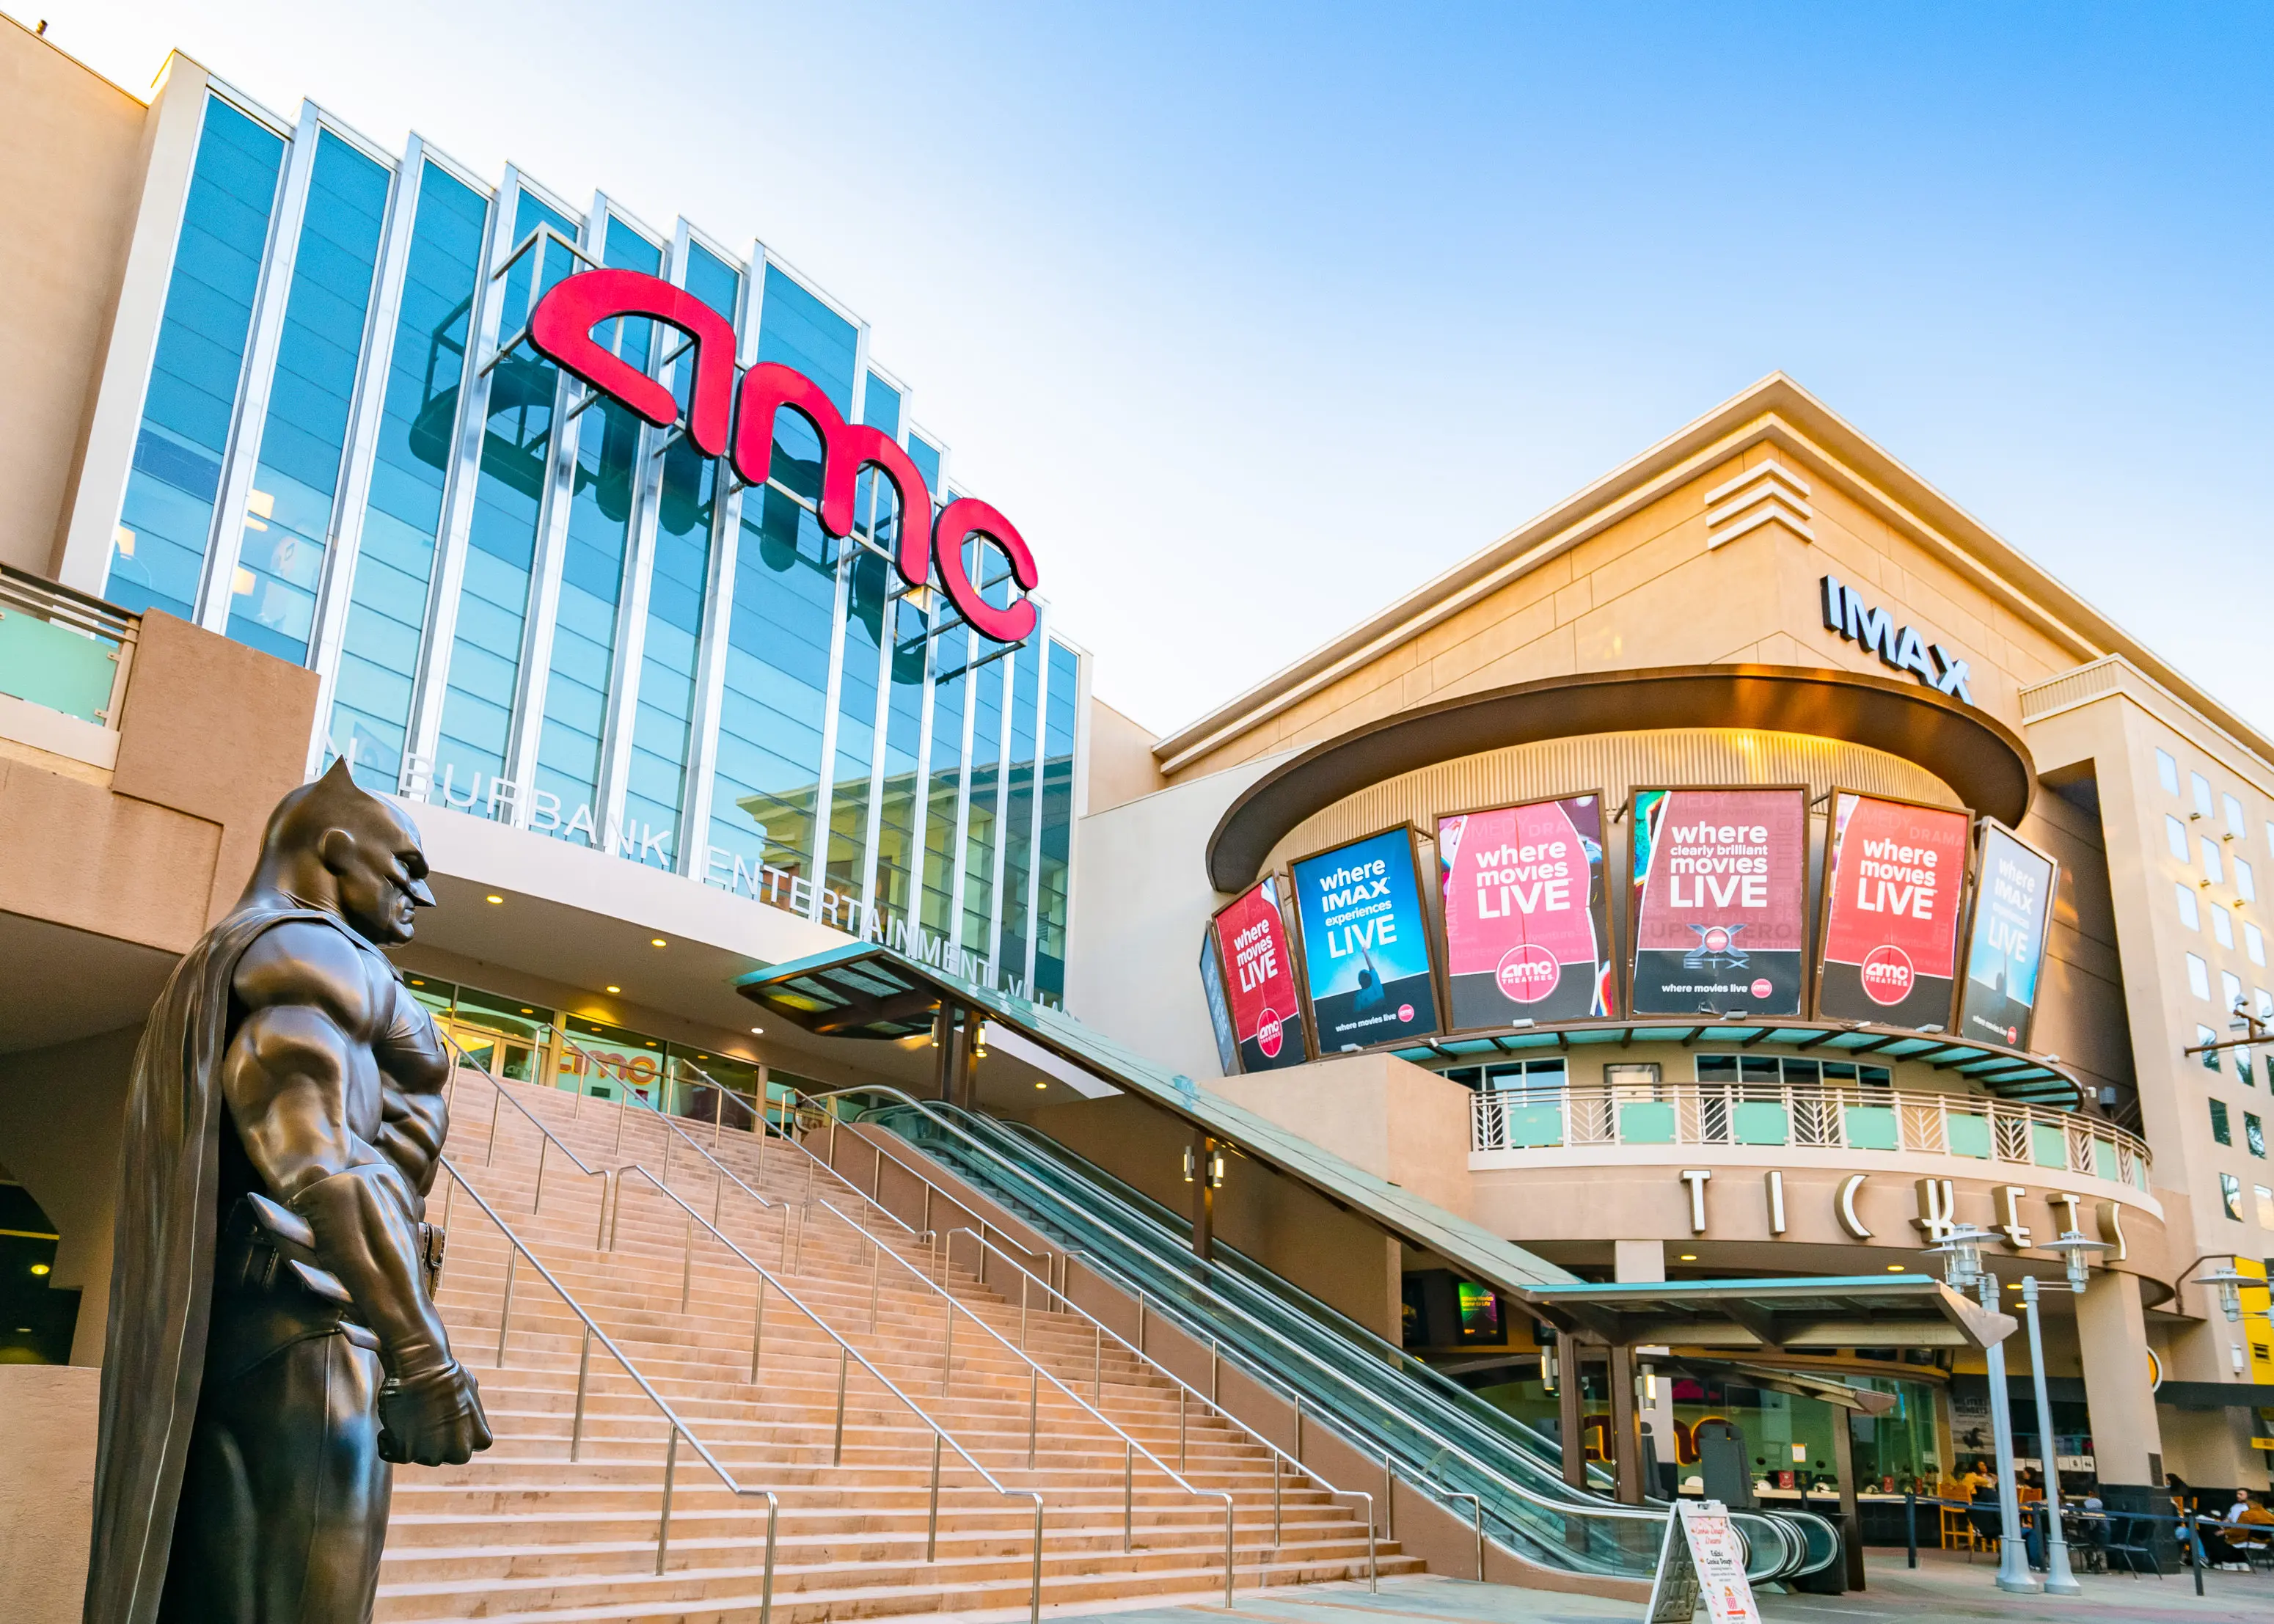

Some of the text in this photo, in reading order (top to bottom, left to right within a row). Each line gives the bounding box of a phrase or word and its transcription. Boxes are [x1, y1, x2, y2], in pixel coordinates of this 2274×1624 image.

[526, 268, 1038, 643] amc
[1820, 574, 1975, 706] IMAX
[1671, 821, 1769, 844] where
[1475, 841, 1567, 868] where
[1670, 845, 1769, 857] clearly brilliant
[1670, 857, 1768, 874] movies
[1863, 838, 1937, 868] where
[399, 752, 673, 866] BURBANK
[703, 845, 993, 989] ENTERTAINMENT
[1320, 859, 1386, 891] where
[1477, 861, 1568, 887] movies
[1860, 860, 1936, 887] movies
[1999, 858, 2035, 893] where
[1322, 877, 1391, 912] IMAX
[1477, 878, 1572, 919] LIVE
[1670, 875, 1767, 907] LIVE
[1857, 877, 1937, 920] LIVE
[1995, 877, 2033, 915] IMAX
[1325, 900, 1392, 927] experiences
[1234, 919, 1269, 951] where
[1327, 914, 1397, 959] LIVE
[1988, 915, 2028, 963] LIVE
[1237, 935, 1273, 967] movies
[1683, 957, 1750, 969] ETX
[1239, 949, 1278, 992] LIVE
[1502, 961, 1552, 977] amc
[1502, 974, 1553, 984] THEATRES
[1865, 962, 1909, 980] amc
[1865, 975, 1908, 987] THEATRES
[1661, 984, 1692, 992] where
[1694, 984, 1728, 992] movies
[1730, 984, 1748, 992] live
[1260, 1020, 1279, 1039] amc
[1335, 1022, 1357, 1032] where
[1358, 1016, 1383, 1028] movies
[1383, 1013, 1397, 1021] live
[1680, 1169, 2127, 1262] TICKETS
